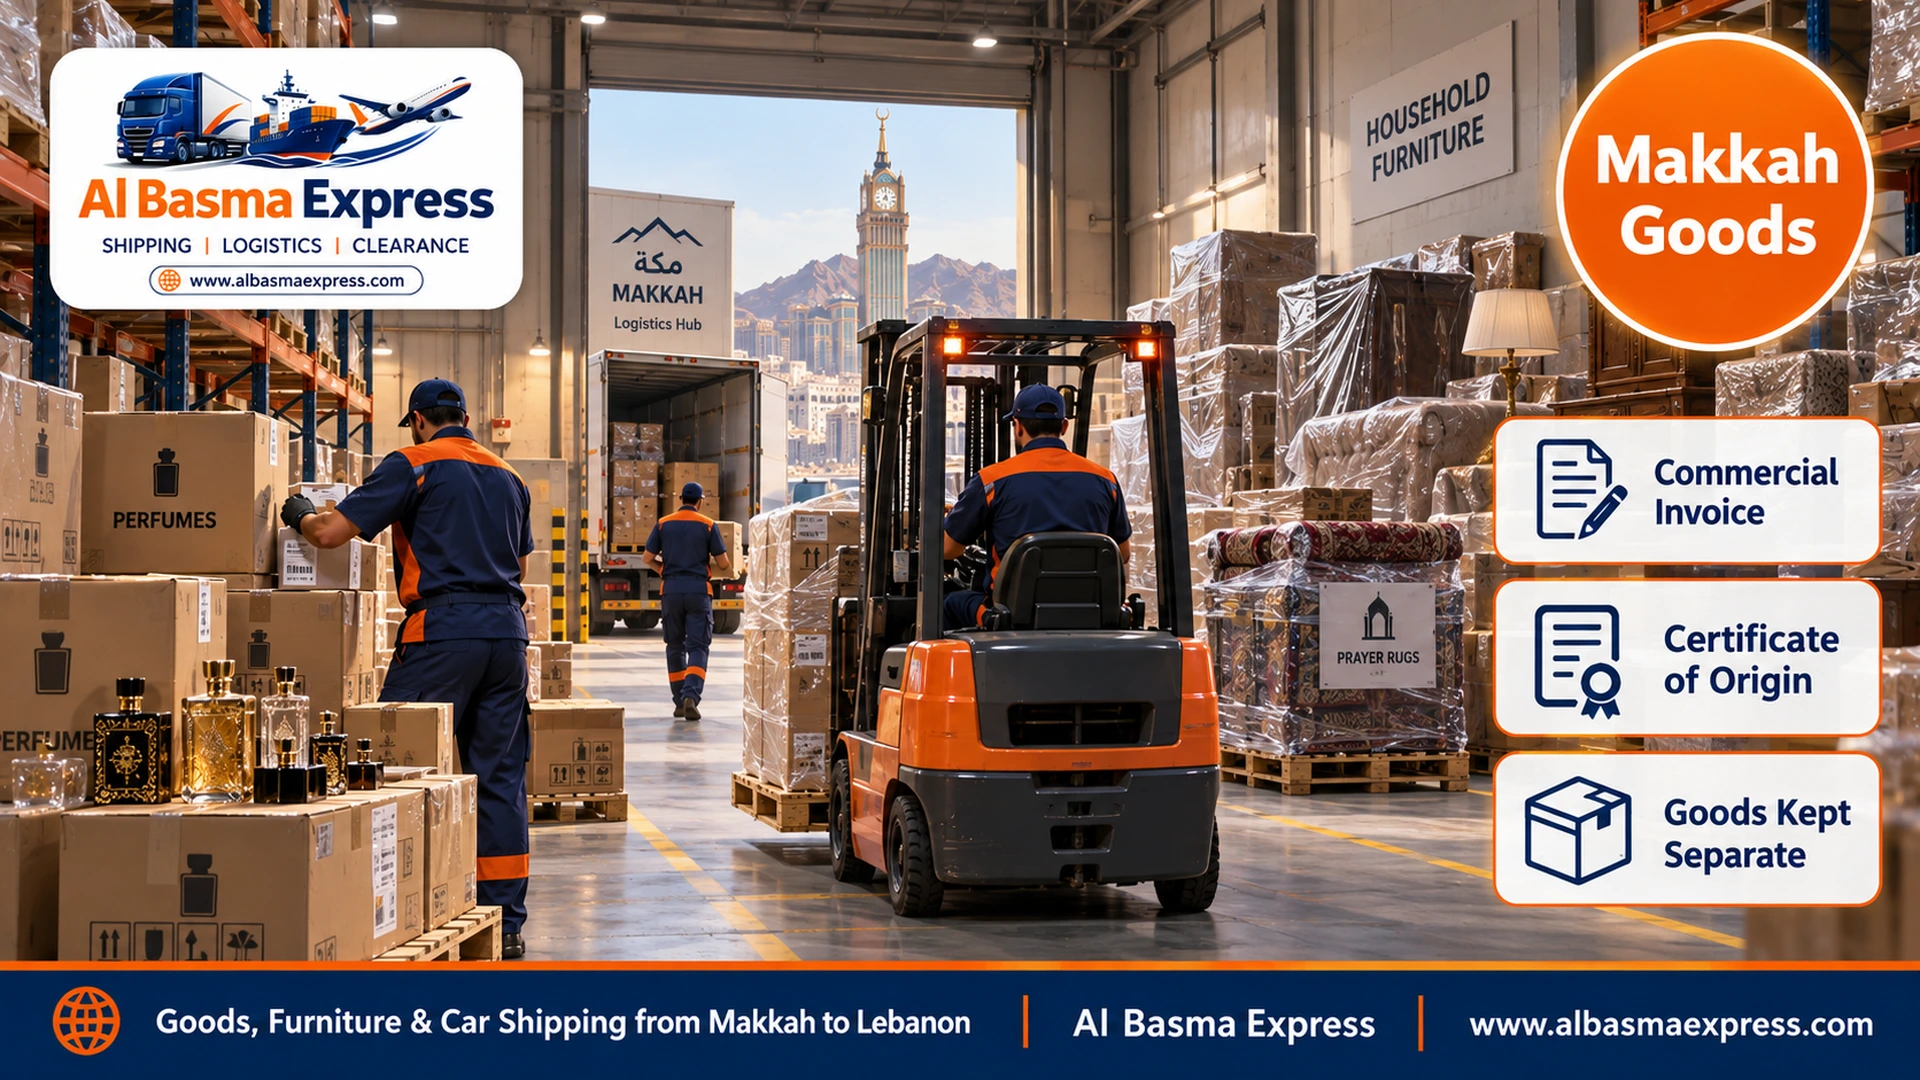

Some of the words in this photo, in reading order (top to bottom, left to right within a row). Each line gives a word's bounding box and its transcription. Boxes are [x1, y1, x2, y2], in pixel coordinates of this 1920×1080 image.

[1367, 72, 1490, 147] HOUSEHOLD
[1373, 114, 1484, 182] FURNITURE
[634, 250, 683, 275] مكة
[613, 284, 703, 304] MAKKAH
[614, 316, 672, 332] Logistics
[676, 317, 702, 331] Hub
[113, 511, 217, 529] PERFUMES
[1337, 651, 1384, 665] PRAYER
[1387, 651, 1420, 664] RUGS
[0, 731, 95, 751] ERFUME
